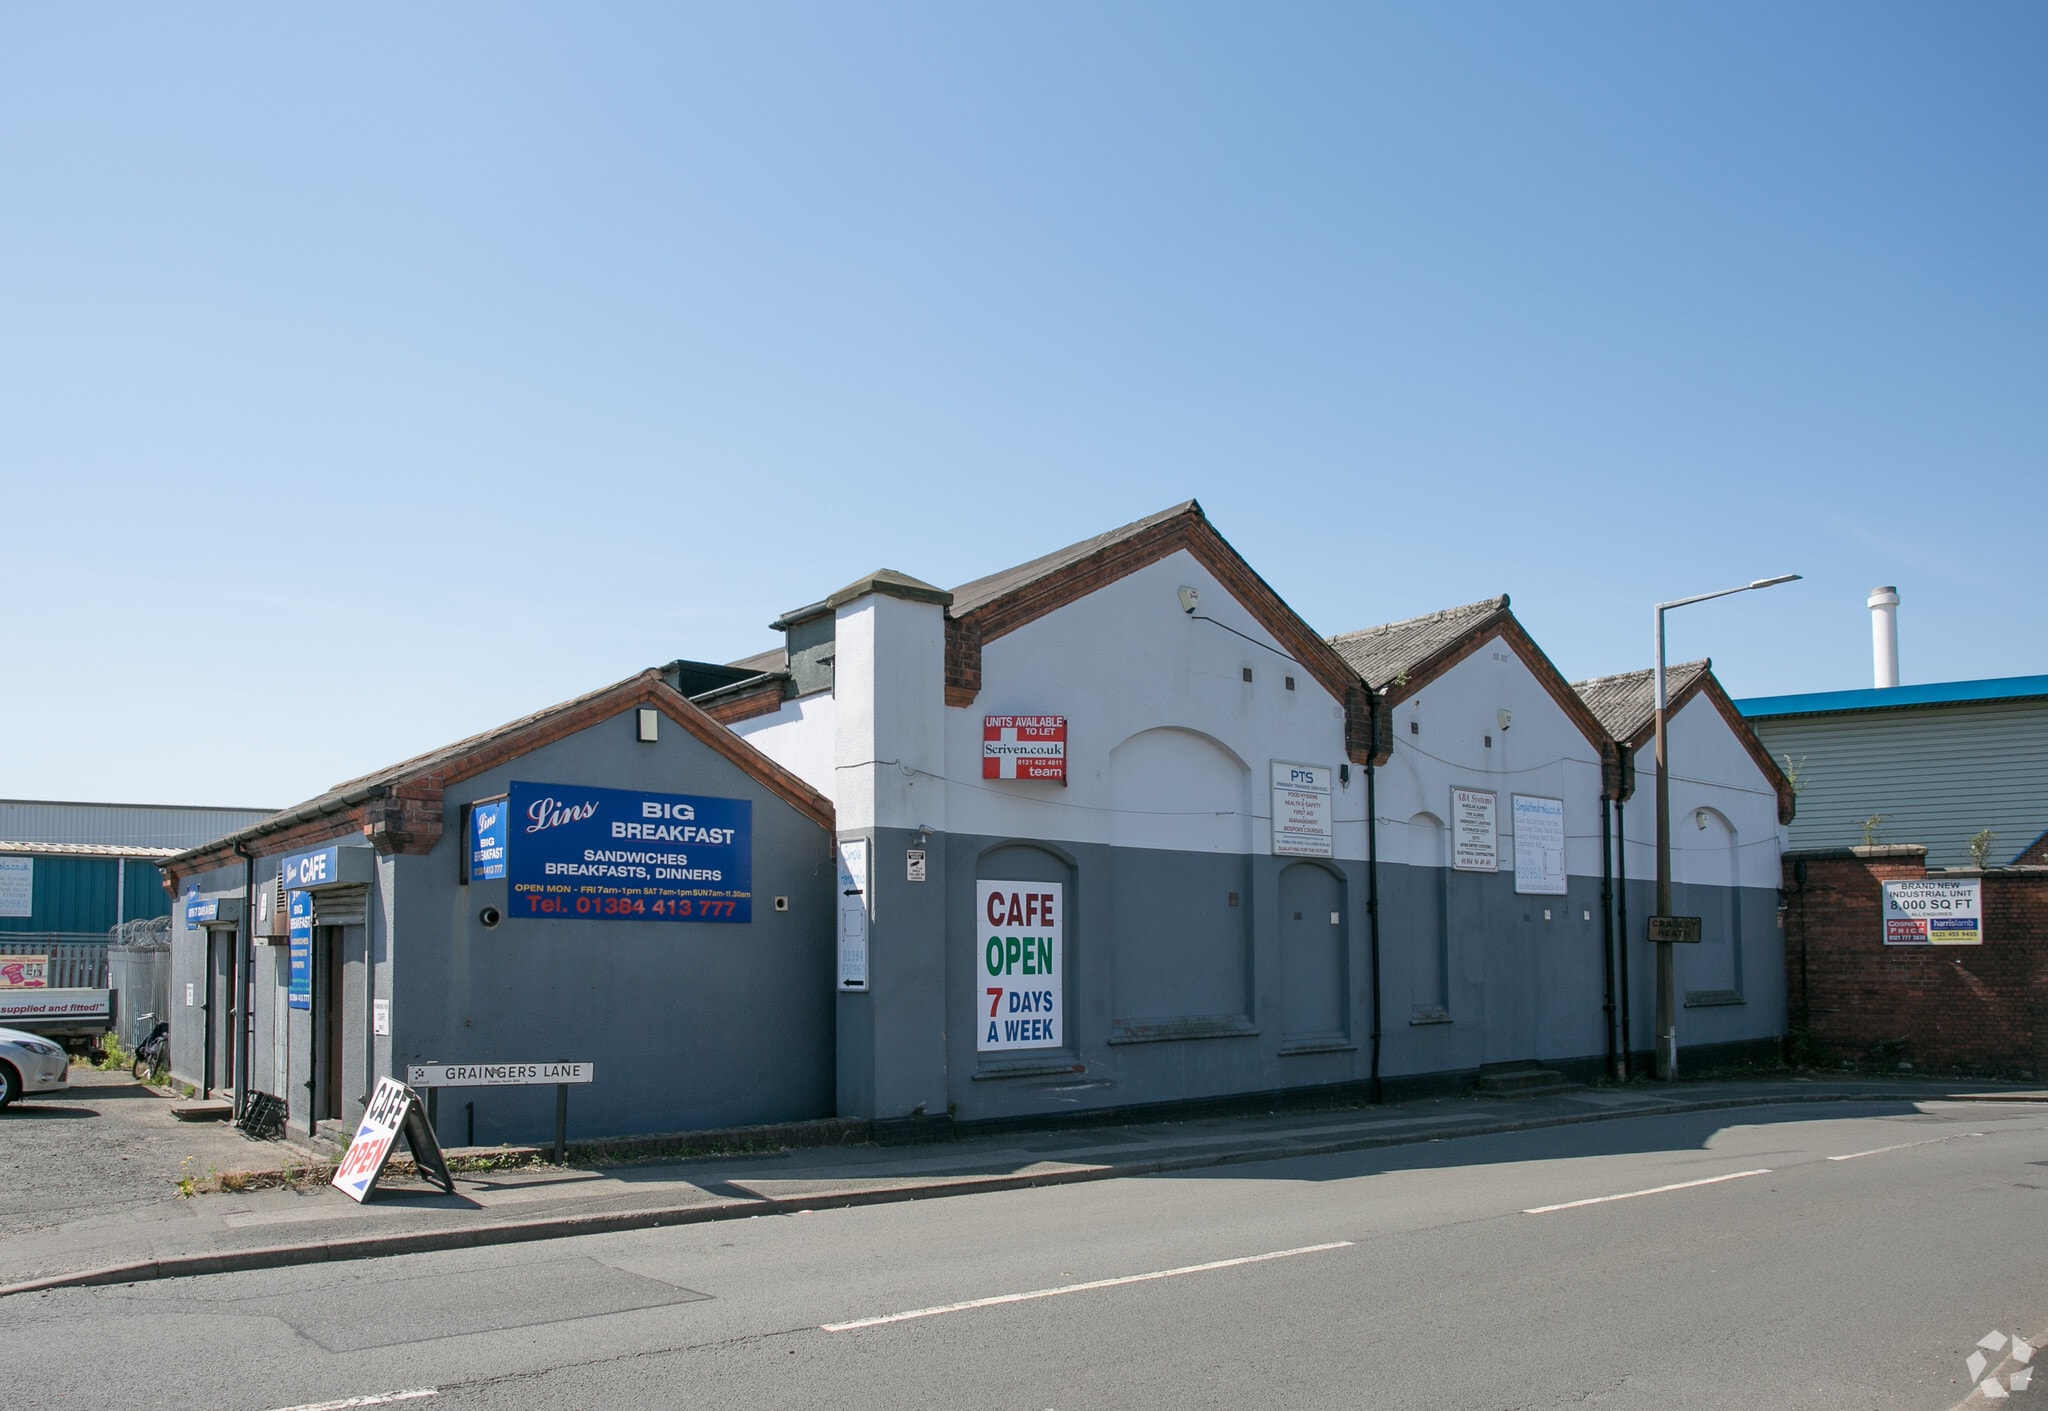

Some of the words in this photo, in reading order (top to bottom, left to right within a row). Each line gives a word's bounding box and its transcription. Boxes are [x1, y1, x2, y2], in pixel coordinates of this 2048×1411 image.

[986, 717, 1013, 727] UNITS
[1016, 717, 1063, 727] AVAILABLE
[1025, 728, 1037, 736] TO
[1040, 728, 1055, 736] LET
[985, 743, 1062, 755] Scriven.co.uk
[1029, 767, 1062, 777] team
[1291, 770, 1314, 784] PTS
[1471, 795, 1492, 805] Systems
[525, 797, 600, 833] Lins
[642, 801, 695, 820] BIG
[478, 812, 498, 835] Lins
[611, 821, 735, 845] BREAKFAST
[480, 837, 495, 847] BIG
[473, 847, 503, 862] BREAKFAST
[583, 849, 688, 866] SANDWICHES
[300, 854, 327, 884] CAFE
[545, 862, 651, 880] BREAKFASTS,
[655, 867, 722, 881] DINNERS
[514, 883, 544, 893] OPEN
[546, 884, 571, 893] MON
[643, 887, 657, 895] SAT
[1901, 882, 1935, 890] BRAND
[1889, 890, 1947, 898] INDUSTRIAL
[293, 904, 303, 914] BIG
[526, 895, 568, 913] Tel.
[576, 896, 646, 915] 01384
[652, 899, 692, 916] 413
[698, 900, 737, 917] 777
[987, 891, 1054, 927] CAFE
[1890, 900, 1926, 911] 8,000
[1930, 900, 1951, 910] SQ
[1955, 899, 1973, 909] FT
[290, 916, 311, 929] BREAKFAST
[1652, 919, 1697, 928] CRADLEY
[1658, 929, 1690, 937] HEATH
[843, 950, 863, 962] 01384
[986, 936, 1053, 976] OPEN
[0, 1005, 46, 1014] supplied
[48, 1004, 67, 1012] and
[986, 988, 1003, 1017] 7
[1009, 991, 1053, 1013] DAYS
[987, 1021, 999, 1042] A
[1005, 1019, 1053, 1041] WEEK
[445, 1067, 537, 1080] GRAINGERS
[543, 1065, 581, 1077] LANE
[369, 1082, 407, 1130] CAFE
[339, 1137, 391, 1177] OPEN
